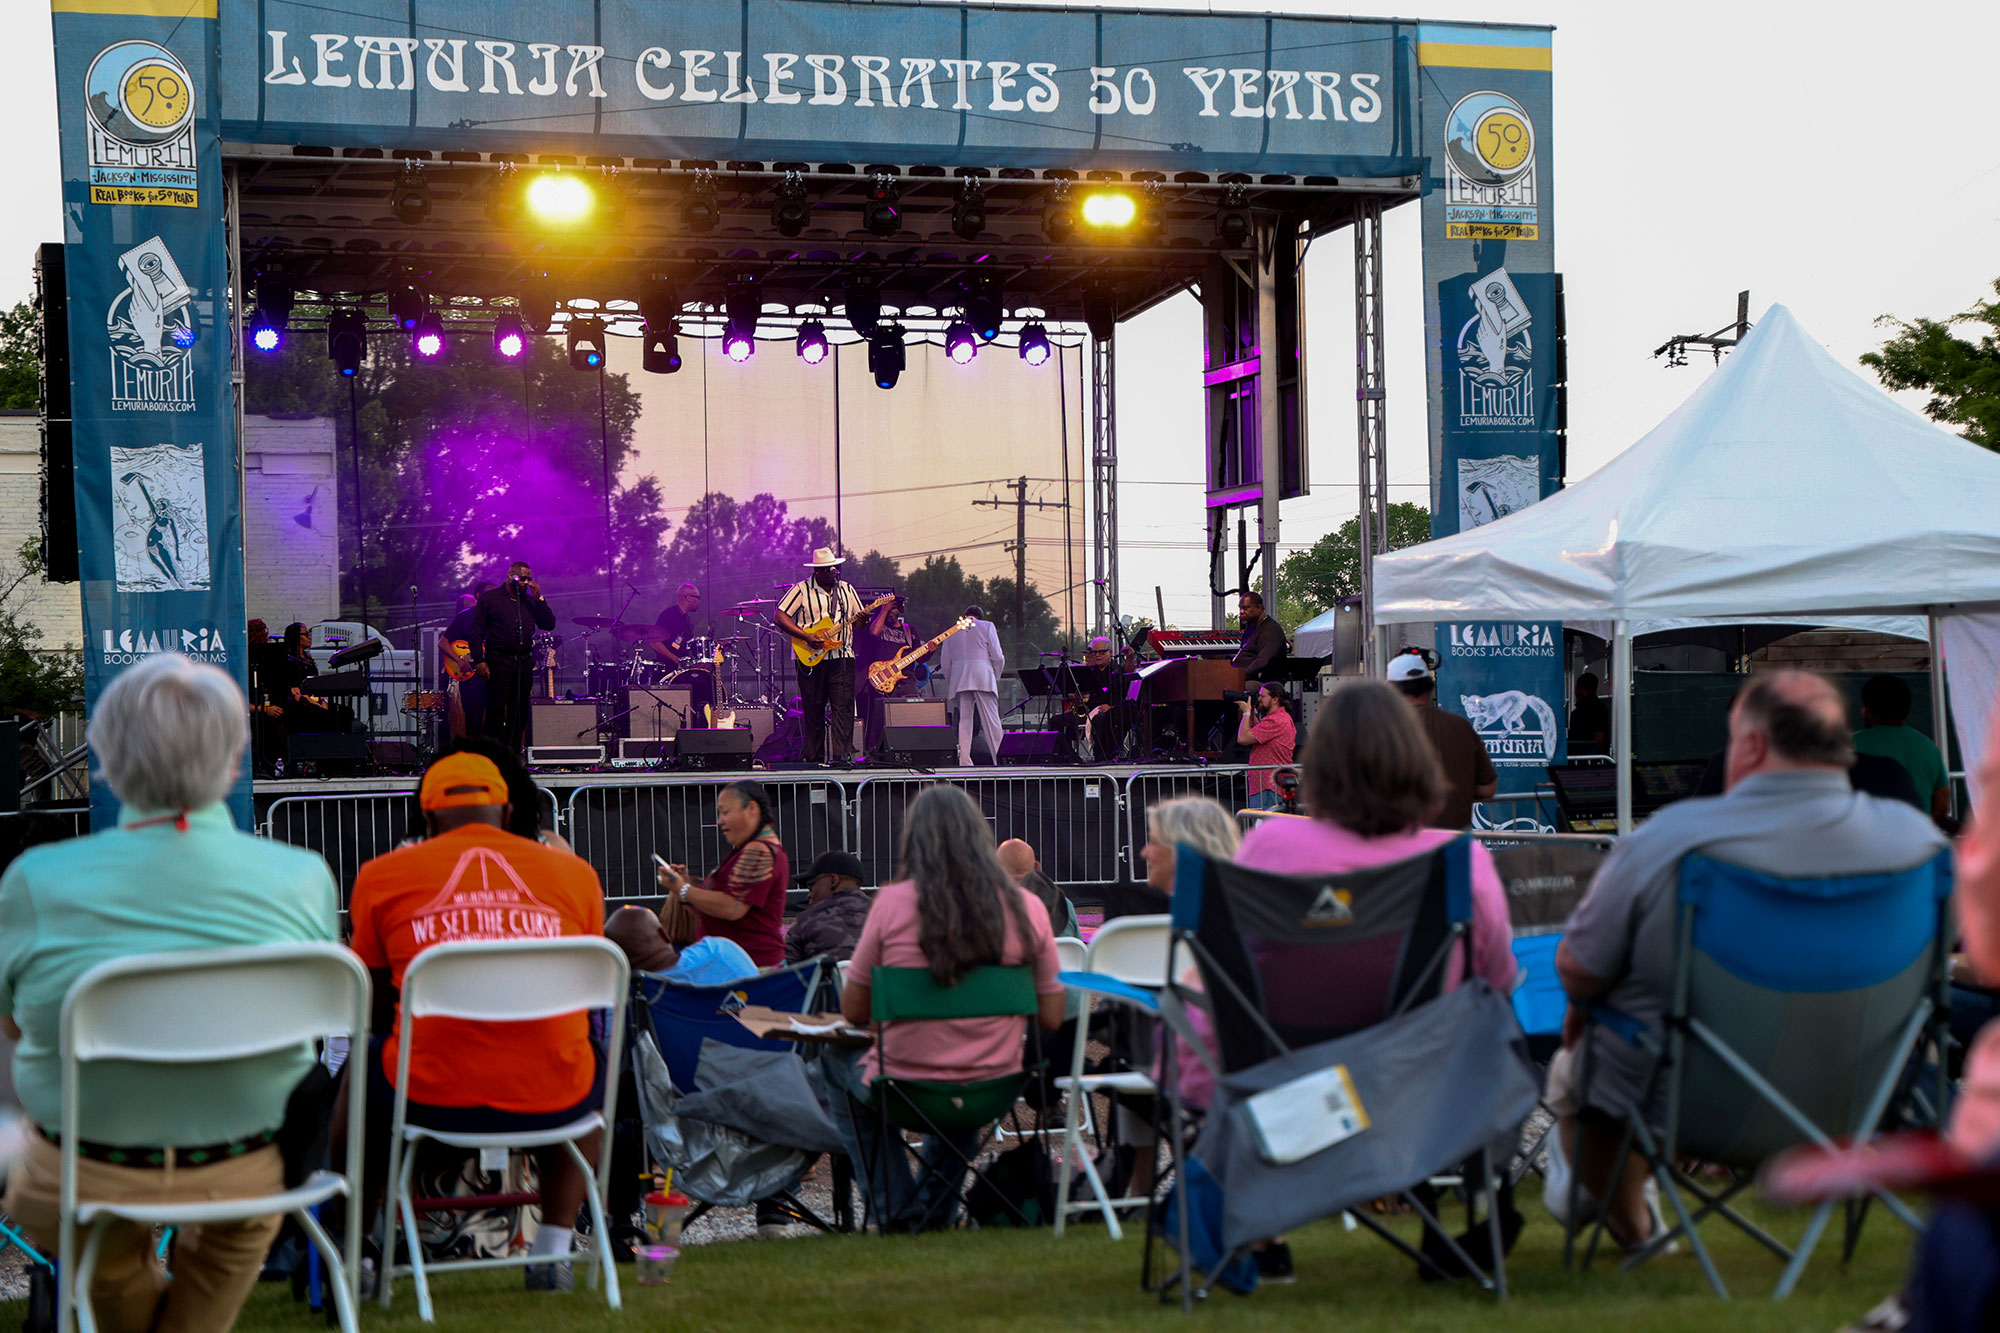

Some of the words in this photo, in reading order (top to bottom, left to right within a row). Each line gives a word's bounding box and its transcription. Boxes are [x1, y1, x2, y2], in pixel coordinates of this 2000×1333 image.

[263, 30, 608, 98] LEMURIA
[635, 47, 1060, 113] CELEBRATES
[1088, 66, 1156, 116] 50
[1183, 67, 1383, 123] YEARS
[139, 76, 179, 117] 50
[89, 121, 196, 168] LEMURIA
[1488, 123, 1522, 160] 50
[95, 188, 116, 202] REAL
[117, 189, 146, 202] BOOKS
[158, 189, 173, 202] 50
[1447, 164, 1537, 205] LEMURIA
[1450, 225, 1468, 237] REAL
[1469, 225, 1493, 237] BOOKS
[109, 346, 196, 402] LEMURIA
[1459, 367, 1535, 417] LEMURIA
[111, 401, 197, 412] LEMURIABOOKS.COM
[1460, 416, 1535, 426] LEMURIABOOKS.COM
[104, 653, 146, 665] BOOKS
[210, 652, 227, 663] MS
[1451, 646, 1486, 657] BOOKS
[1489, 646, 1539, 657] JACKSON
[1541, 647, 1555, 657] MS
[1483, 739, 1544, 754] MURIA
[411, 914, 436, 945] WE
[441, 909, 470, 936] SET
[475, 908, 505, 933] THE
[509, 908, 562, 938] CURVE
